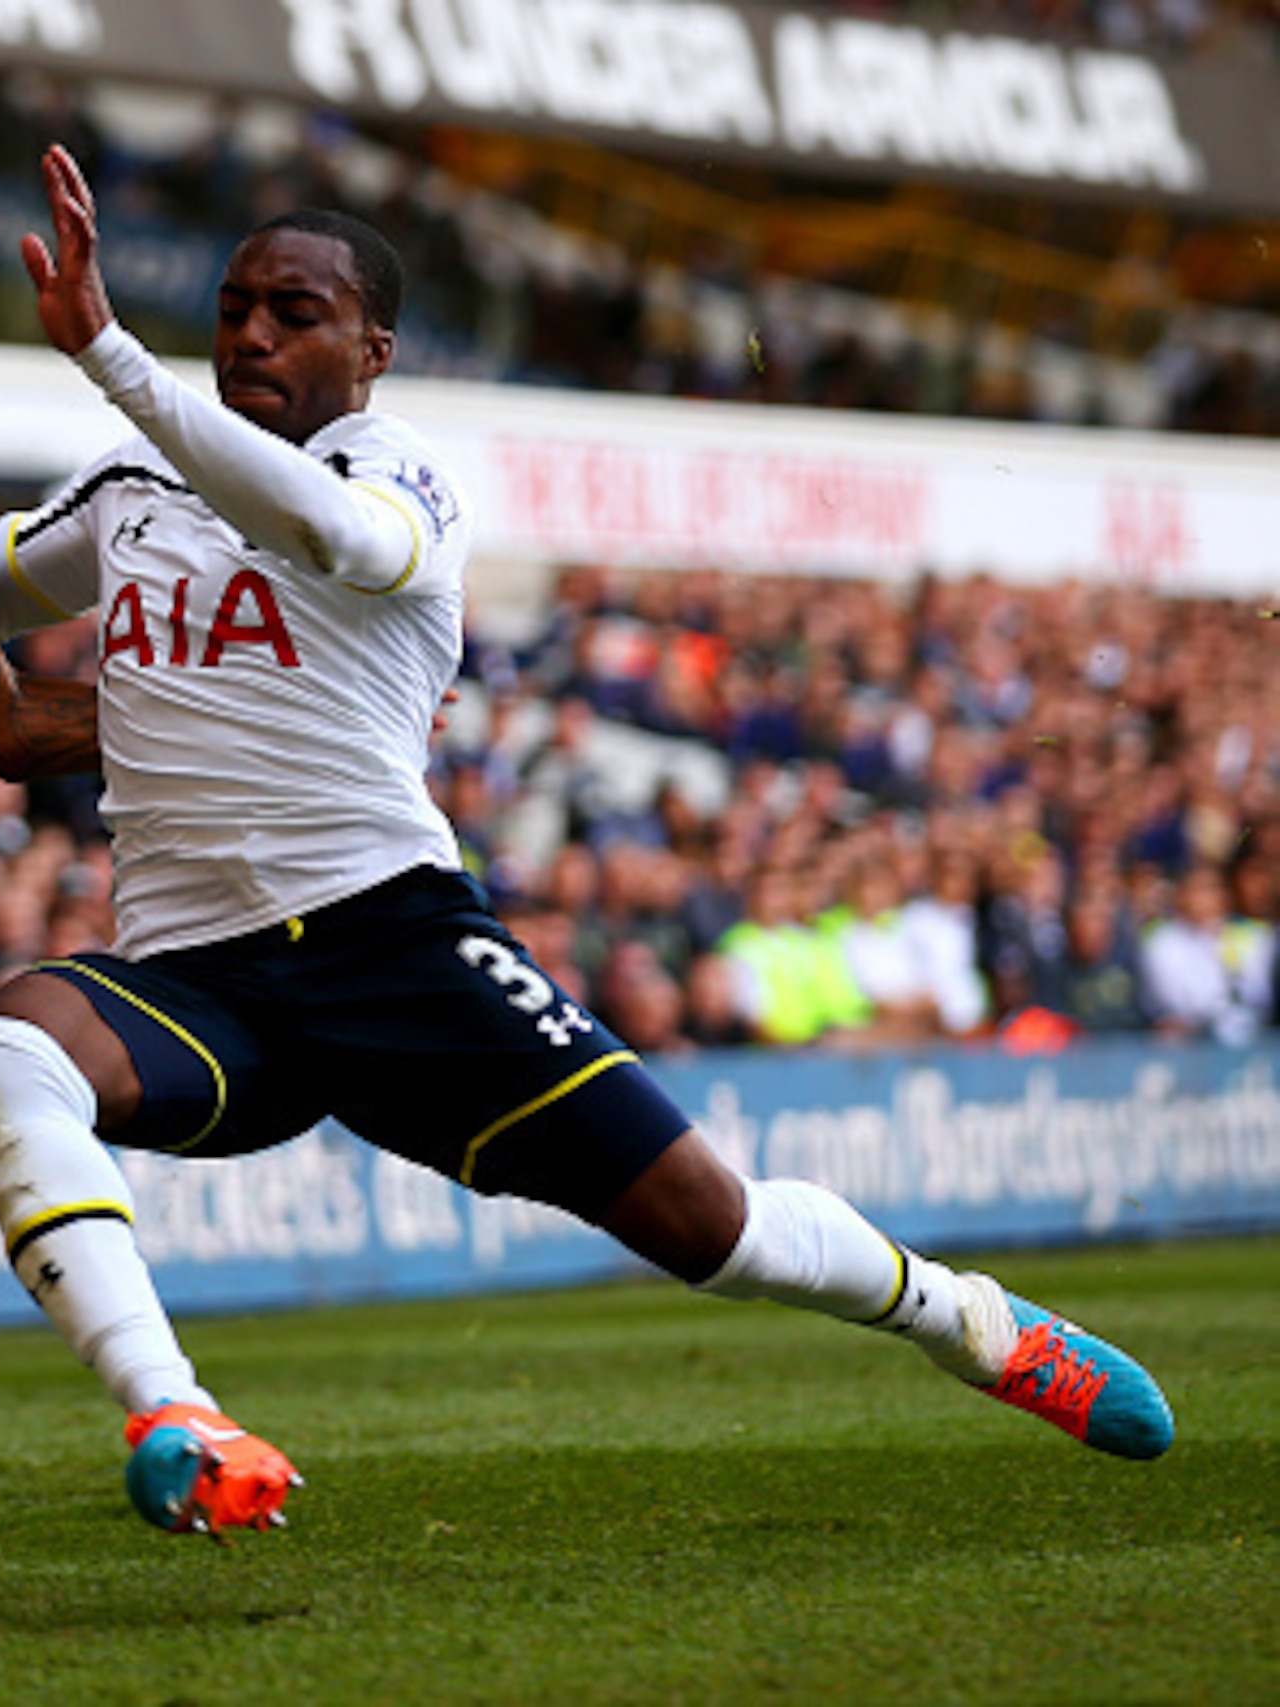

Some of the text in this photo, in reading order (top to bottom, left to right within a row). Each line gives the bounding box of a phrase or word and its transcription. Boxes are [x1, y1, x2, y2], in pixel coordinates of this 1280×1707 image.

[774, 14, 1206, 193] ARMOUR
[102, 569, 302, 668] AIA
[456, 935, 553, 1015] 3
